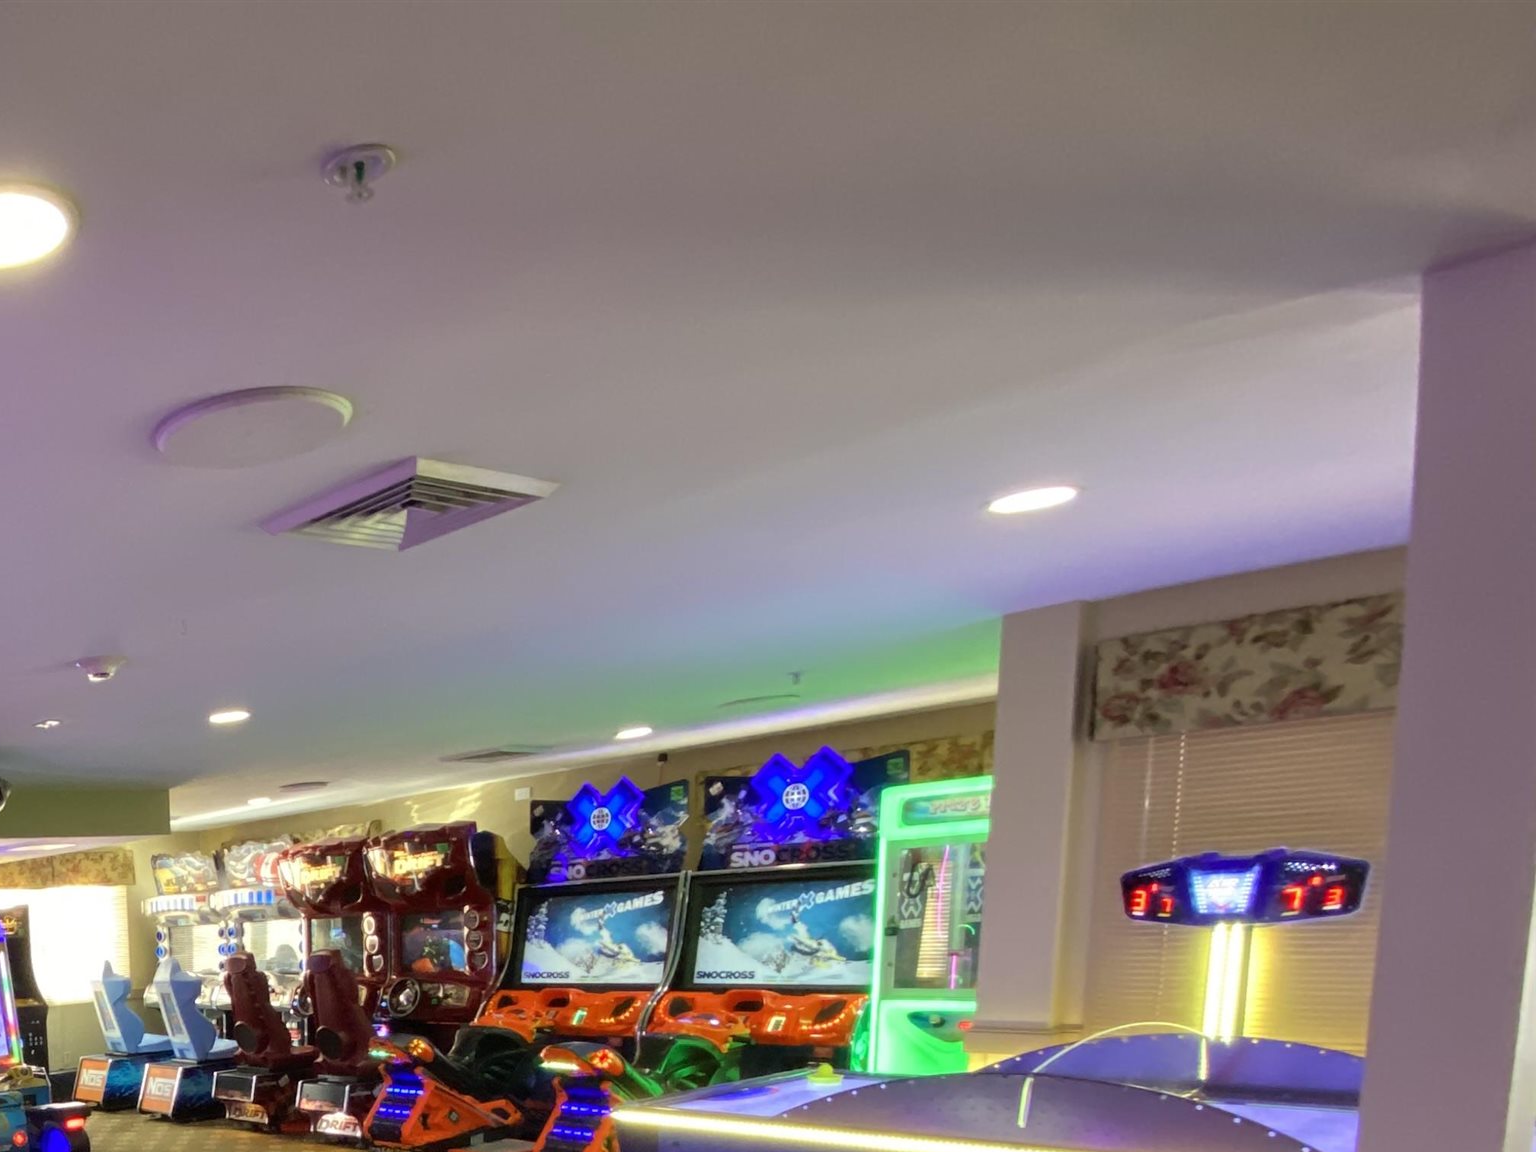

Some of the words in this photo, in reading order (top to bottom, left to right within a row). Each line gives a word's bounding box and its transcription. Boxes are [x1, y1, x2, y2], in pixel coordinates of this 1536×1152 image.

[815, 878, 875, 905] GAMES
[617, 891, 664, 913] GAMES
[523, 971, 570, 979] SNOCROSS
[696, 971, 755, 980] SNOCROSS
[147, 1077, 174, 1097] NOS
[317, 1118, 359, 1133] DRIFT
